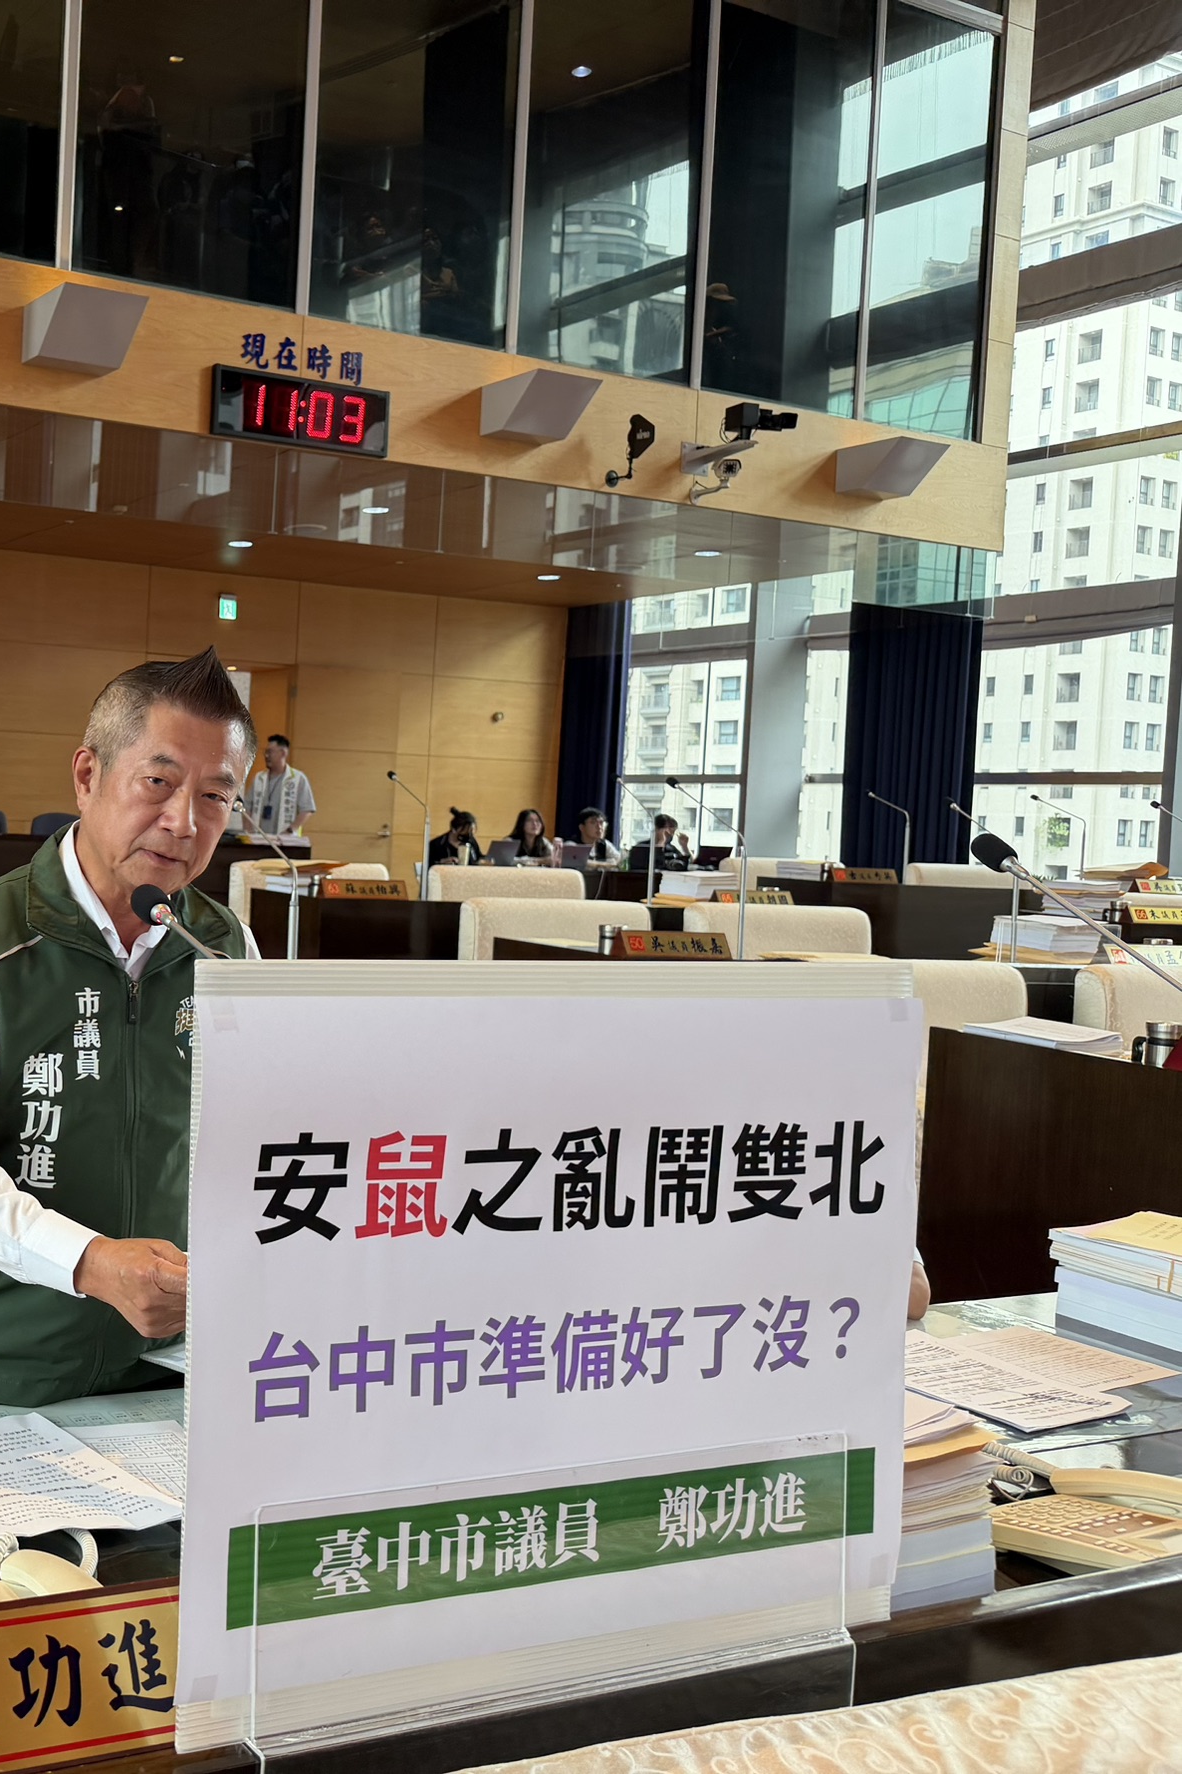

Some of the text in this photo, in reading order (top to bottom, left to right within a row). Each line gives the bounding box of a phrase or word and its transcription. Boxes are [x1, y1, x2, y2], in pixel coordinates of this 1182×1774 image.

[241, 333, 363, 386] 現在時間
[255, 384, 367, 444] 11:03
[629, 936, 644, 950] 50
[73, 986, 101, 1080] 市議員
[14, 1052, 64, 1189] 鄭功進
[253, 1120, 886, 1245] 安鼠之亂鬧雙北
[248, 1295, 861, 1423] 台中市準備好了沒？
[312, 1472, 807, 1600] 臺中市議員 鄭功進
